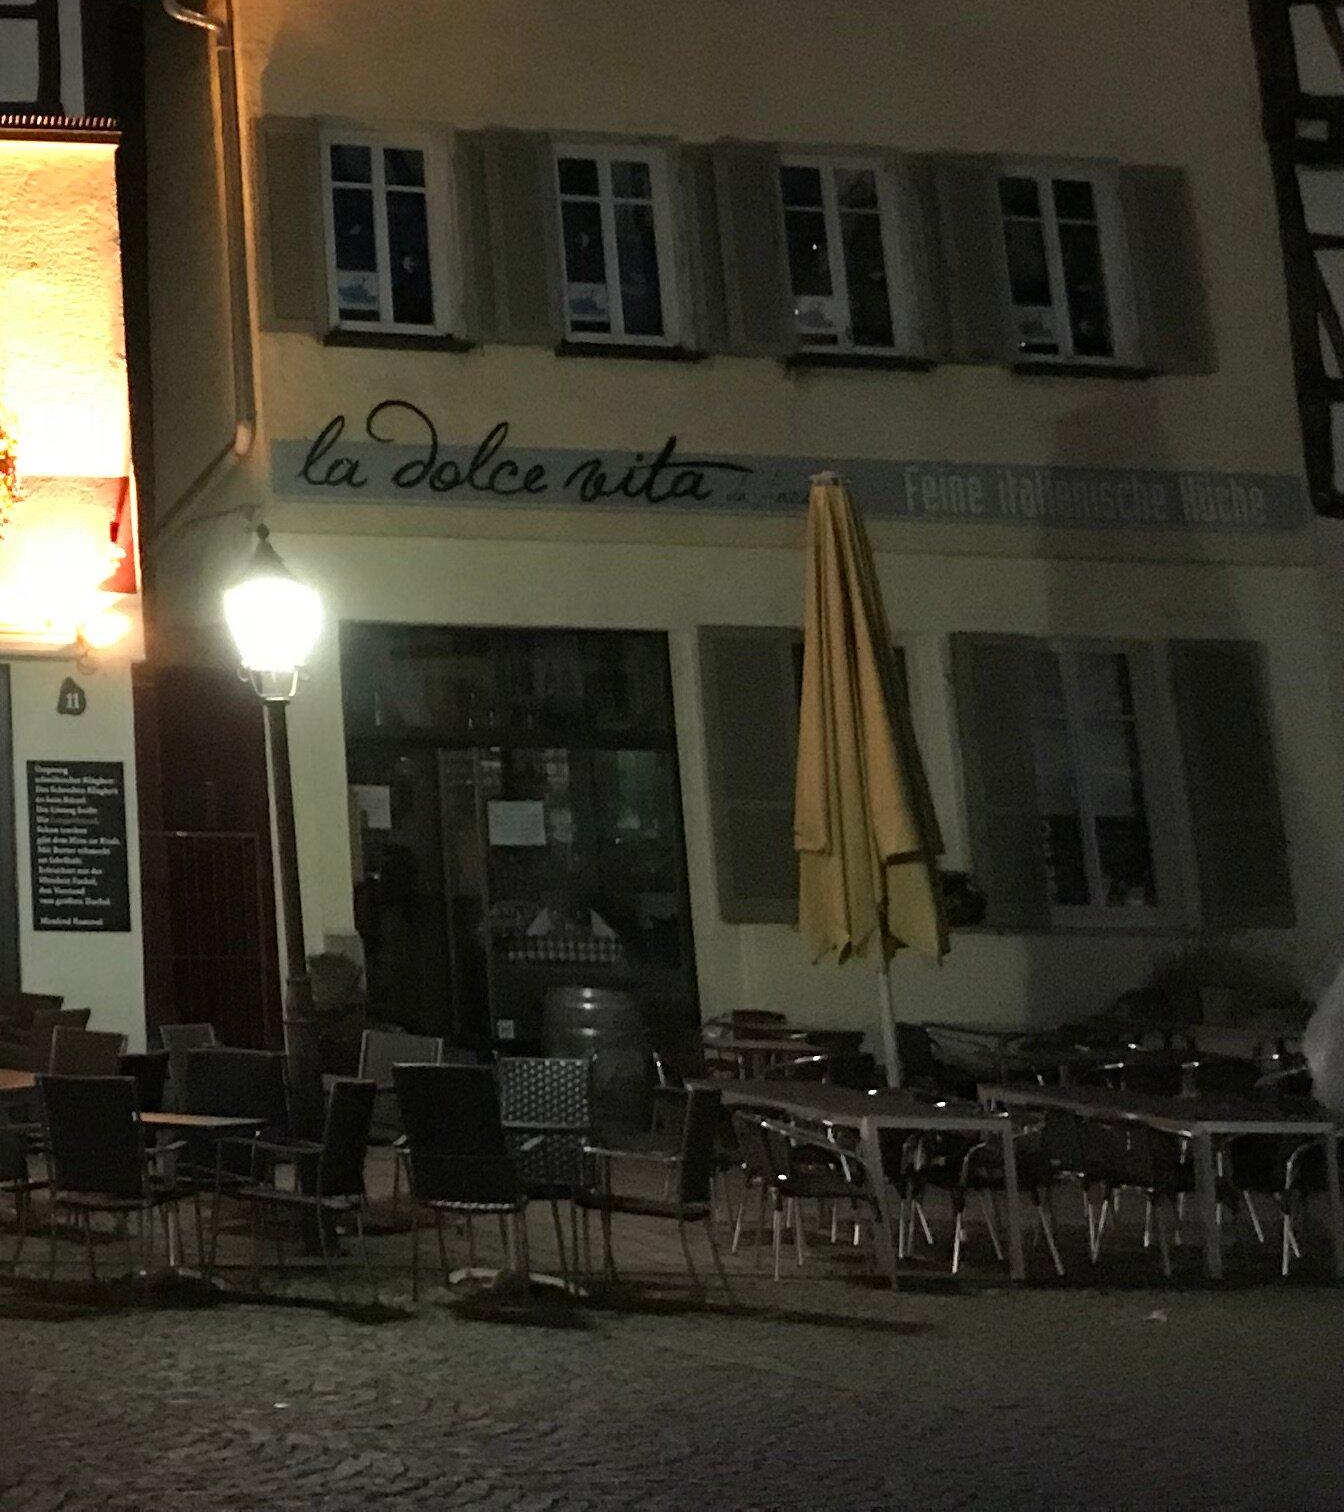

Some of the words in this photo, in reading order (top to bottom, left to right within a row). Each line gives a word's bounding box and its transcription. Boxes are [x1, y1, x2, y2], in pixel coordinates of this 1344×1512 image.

[297, 414, 367, 488] la
[367, 399, 549, 496] dolce
[566, 434, 754, 503] vita
